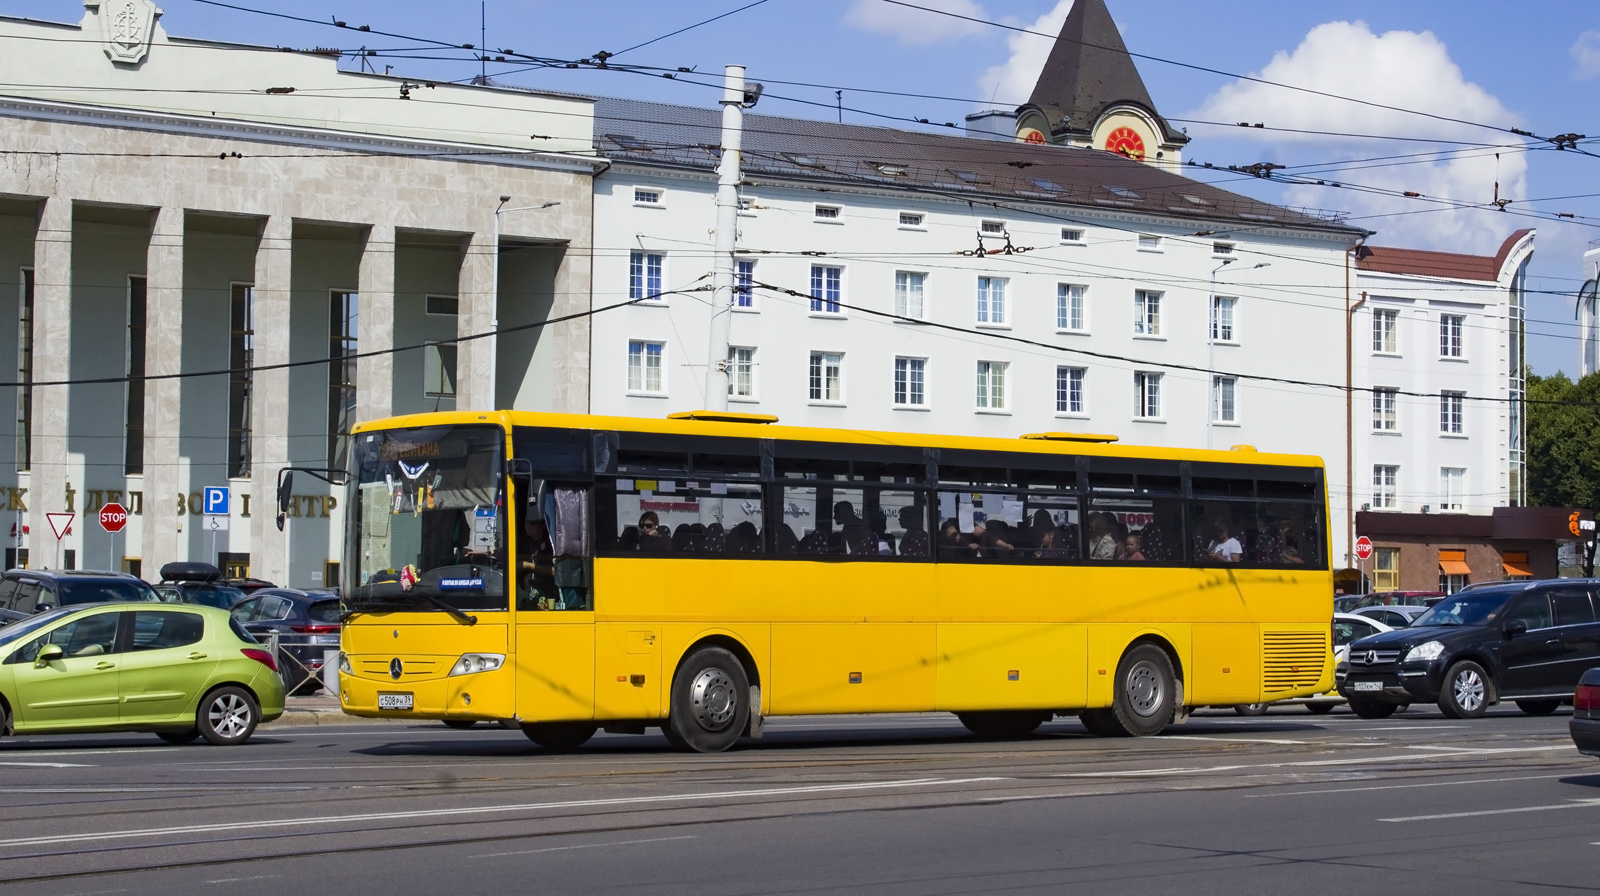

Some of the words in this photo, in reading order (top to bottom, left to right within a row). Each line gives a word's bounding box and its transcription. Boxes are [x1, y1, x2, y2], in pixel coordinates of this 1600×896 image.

[209, 489, 224, 512] P
[101, 512, 126, 523] STOP
[1356, 544, 1371, 552] STOP
